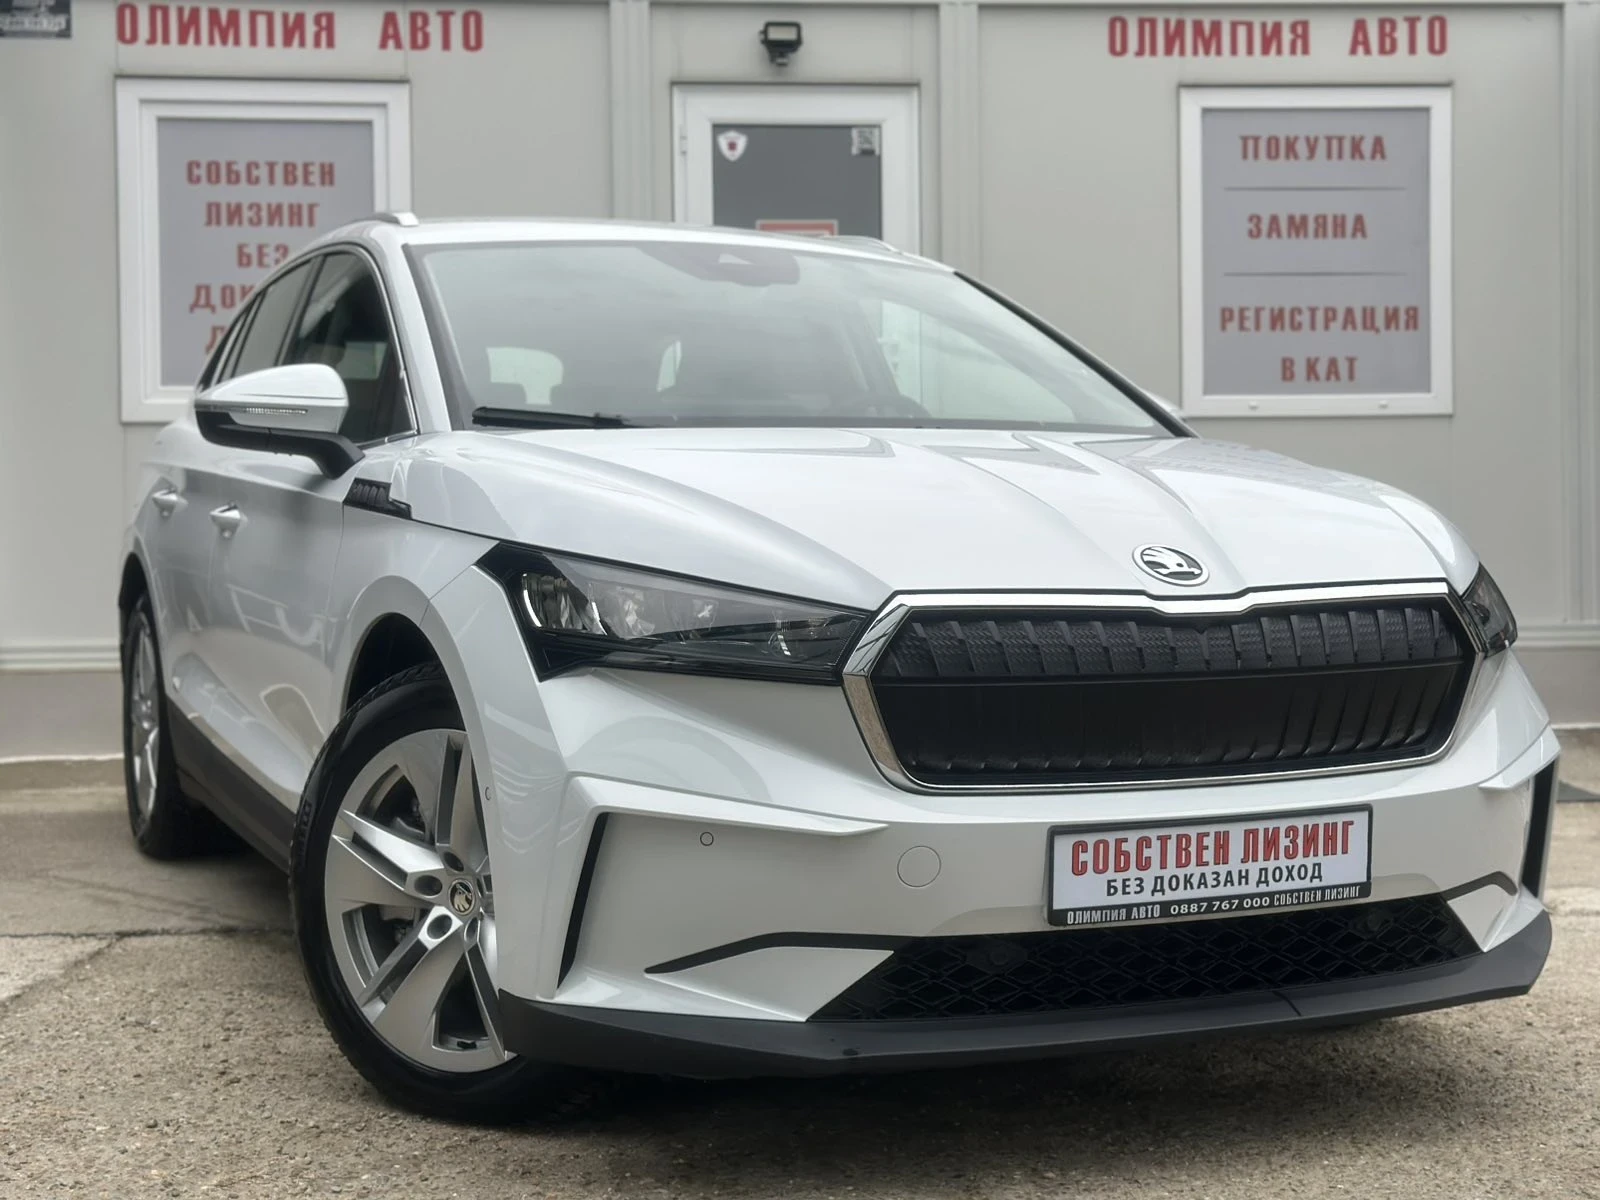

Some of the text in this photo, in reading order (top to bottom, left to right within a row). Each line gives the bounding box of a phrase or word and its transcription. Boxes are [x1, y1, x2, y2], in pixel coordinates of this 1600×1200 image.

[115, 2, 337, 50] ОЛИМПИЯ
[378, 9, 485, 53] АВТО
[1107, 15, 1450, 58] ОЛИМПИЯ АВТО
[1240, 135, 1387, 162] ПОКУПКА
[186, 159, 337, 188] СОБСТВЕН
[204, 201, 321, 229] ЛИЗИНГ
[1247, 213, 1368, 241] ЗАМЯНА
[1219, 305, 1420, 335] РЕГИСТРАЦИЯ
[1281, 356, 1359, 383] В КАТ
[1071, 820, 1355, 877] СОБСТВЕН ЛИЗИНГ
[1106, 862, 1323, 897] БЕЗ ДОКАЗАН ДОХОД
[1067, 885, 1361, 925] ОЛИМПИЯ АВТО 0887 767 000 СОБСТВЕН ЛИЗИНГ
